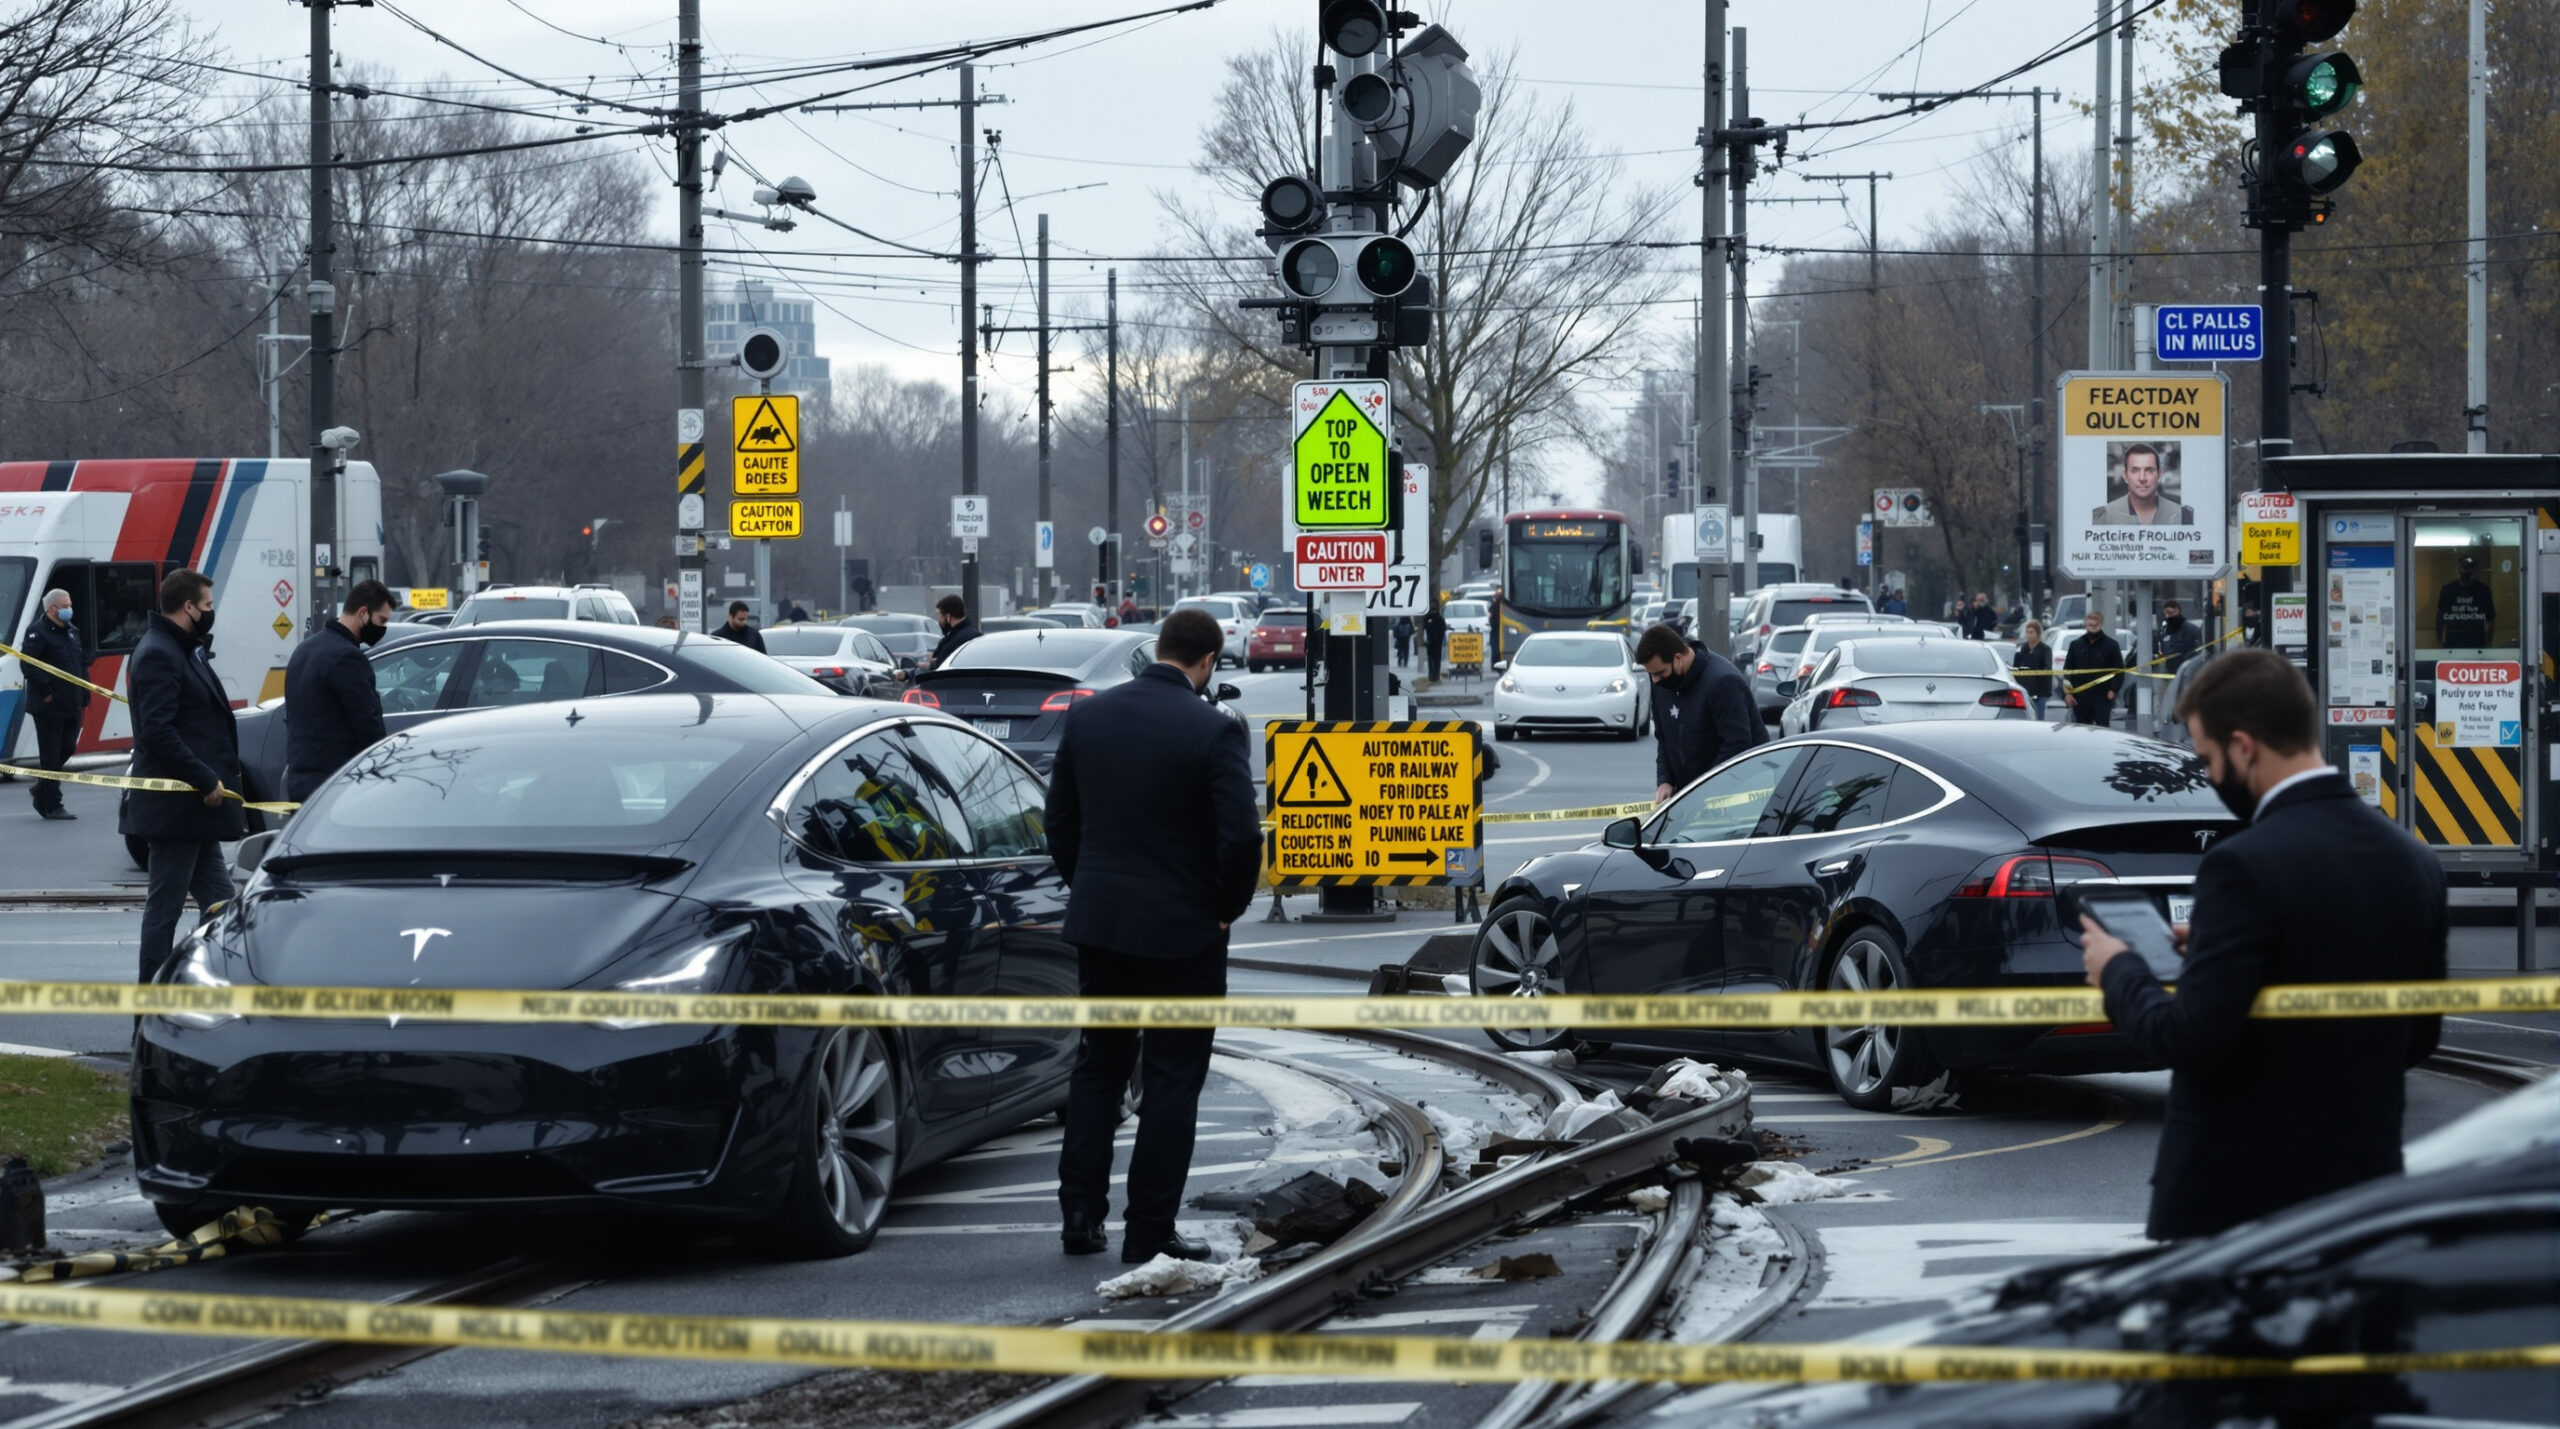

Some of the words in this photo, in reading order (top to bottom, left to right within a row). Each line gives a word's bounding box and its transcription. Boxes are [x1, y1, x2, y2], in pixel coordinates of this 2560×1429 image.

[2192, 312, 2251, 329] PALLS
[2166, 334, 2185, 350] IN
[2089, 387, 2199, 405] FEACTDAY
[1325, 419, 1358, 438] TOP
[2086, 411, 2200, 429] QULCTION
[1329, 441, 1351, 460] TO
[1311, 462, 1369, 484] OPEEN
[1307, 490, 1371, 511] WEECH
[740, 505, 794, 518] CAUTION
[1306, 541, 1376, 560] CAUTION
[2448, 668, 2509, 682] COUTER
[1369, 762, 1396, 778] FOR
[1400, 762, 1459, 778] RAILWAY
[1359, 804, 1394, 820] NOEY
[1398, 804, 1415, 820] TO
[1281, 834, 1335, 850] COUCTIS
[1369, 825, 1427, 842] PLUNING
[1431, 825, 1464, 841] LAKE
